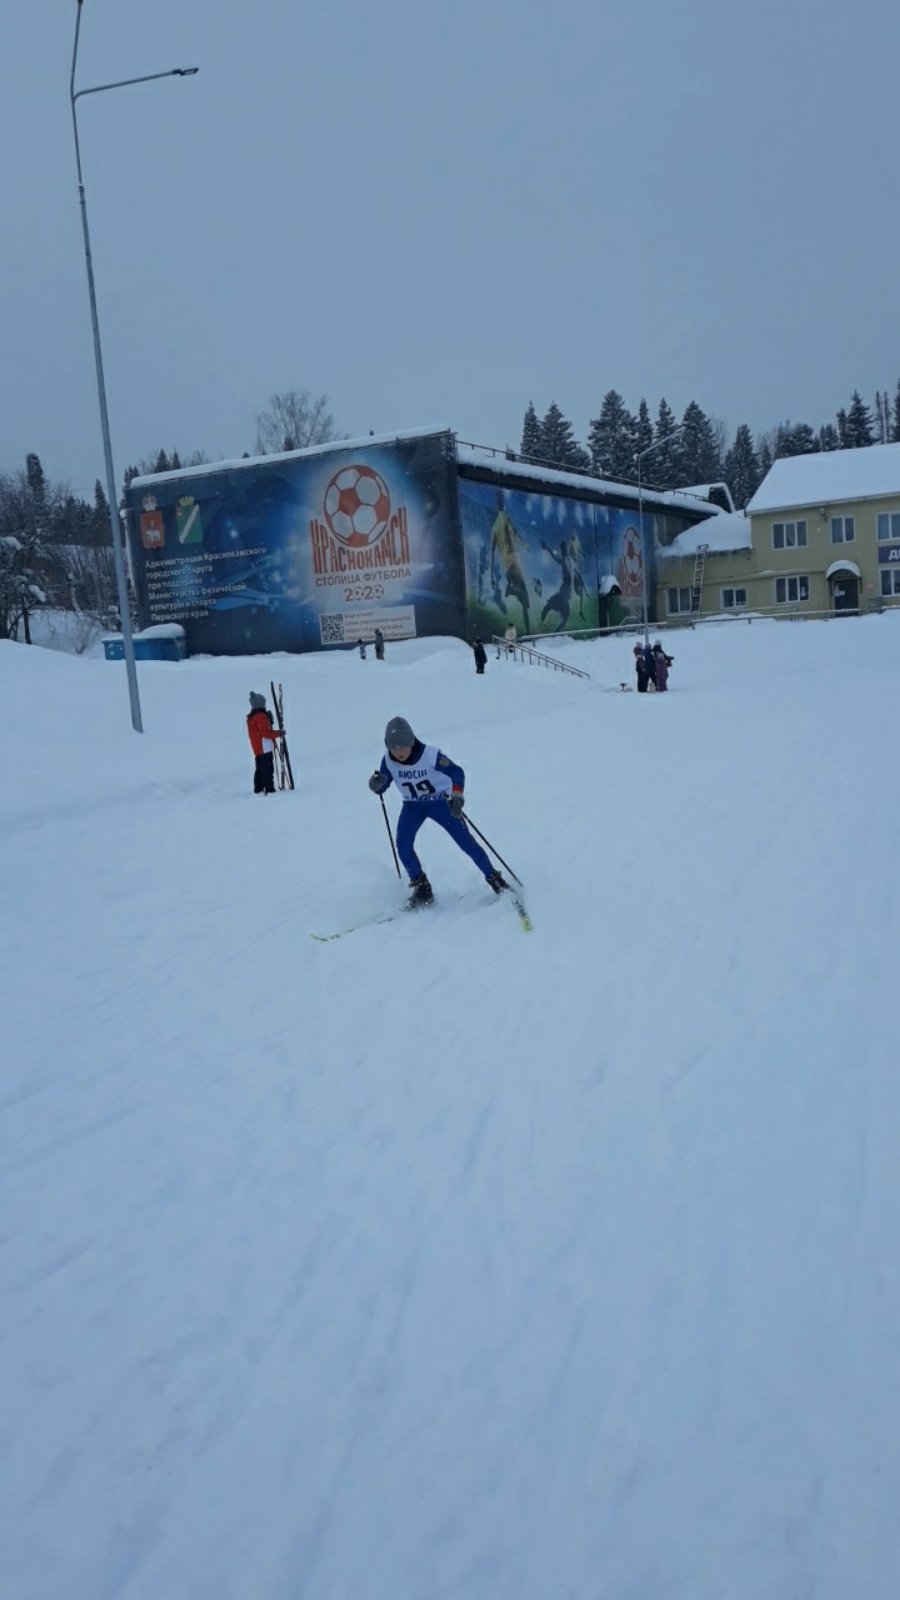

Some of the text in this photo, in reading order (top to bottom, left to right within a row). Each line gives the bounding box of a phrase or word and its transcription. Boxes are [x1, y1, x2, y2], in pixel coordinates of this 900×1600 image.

[310, 507, 410, 574] КРАСНОКАМСК
[204, 547, 267, 561] Краснокамского
[888, 549, 900, 561] Д
[316, 568, 411, 587] СТОЛИЦА ФУТБОЛА
[344, 585, 385, 602] 2020
[151, 611, 190, 622] Пермского
